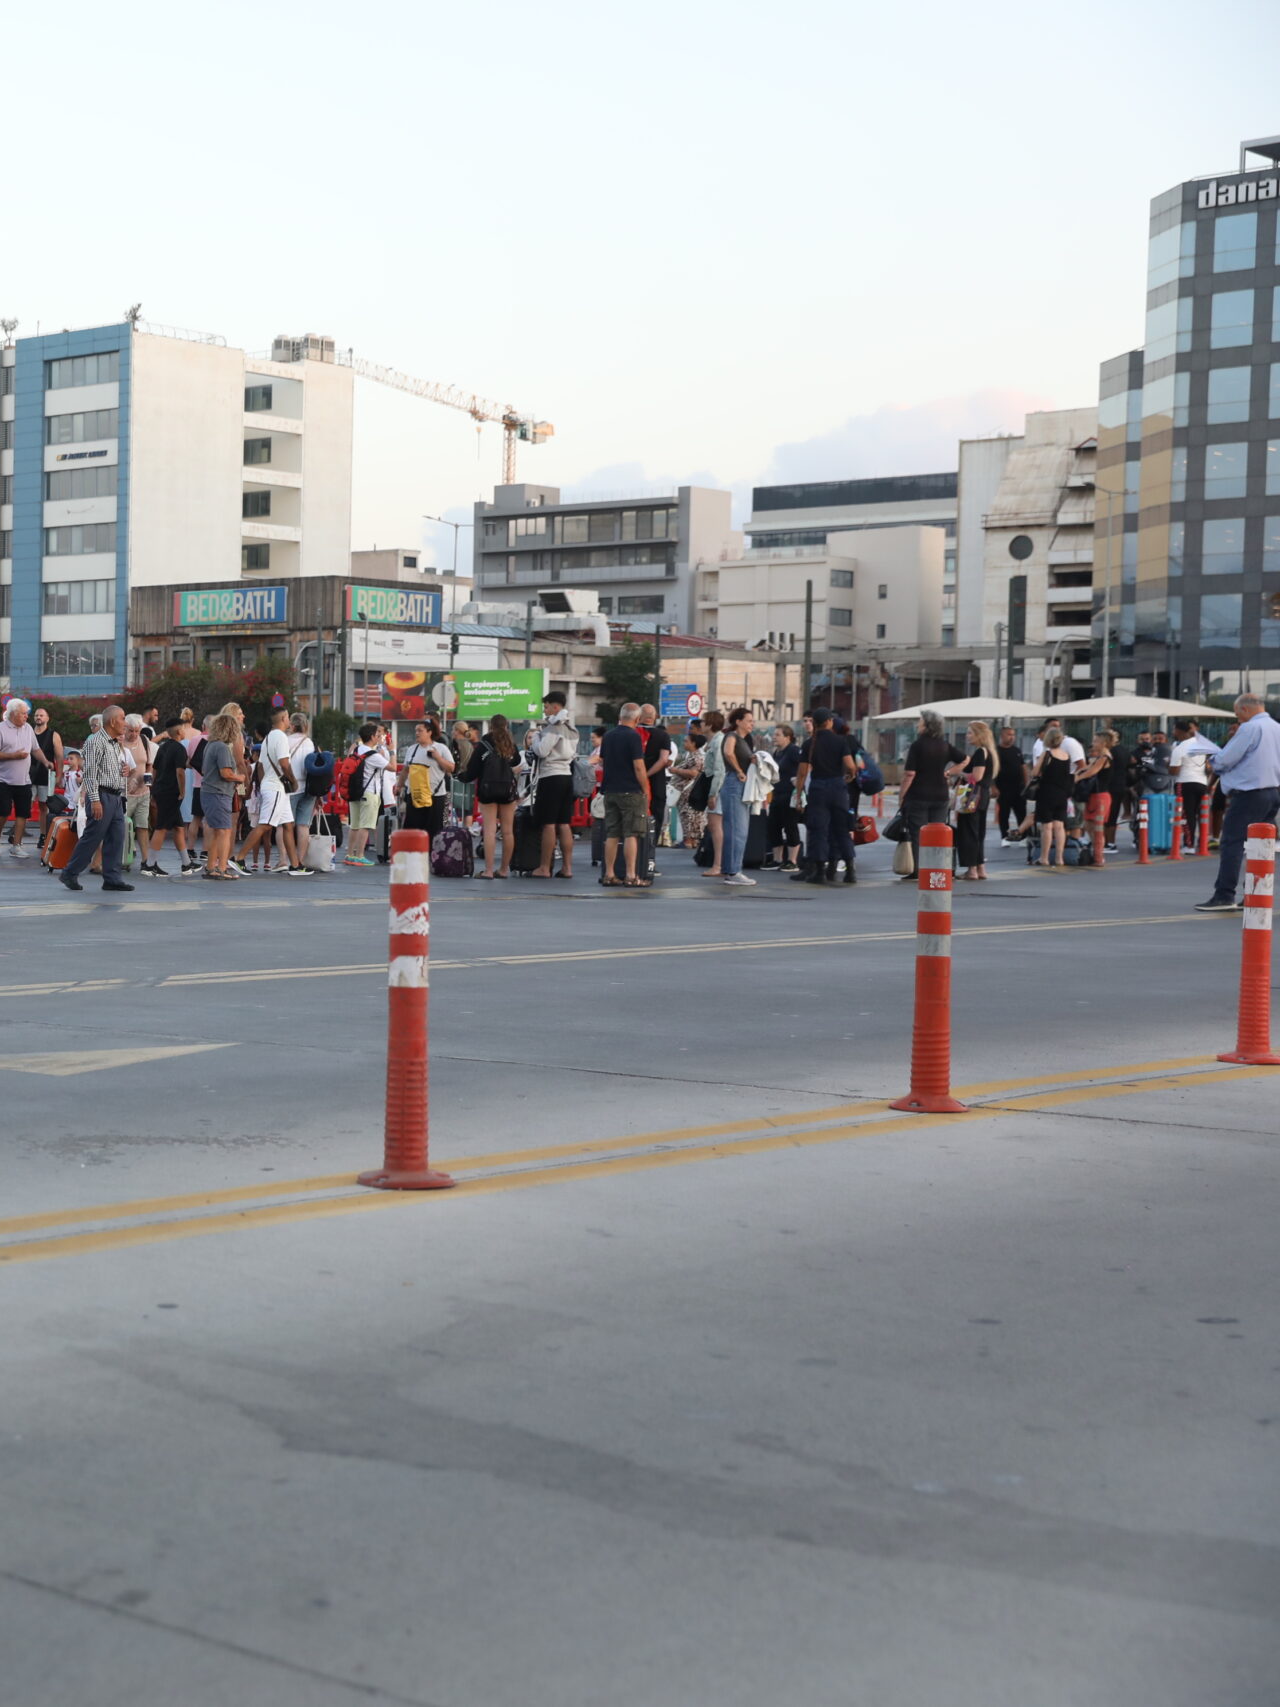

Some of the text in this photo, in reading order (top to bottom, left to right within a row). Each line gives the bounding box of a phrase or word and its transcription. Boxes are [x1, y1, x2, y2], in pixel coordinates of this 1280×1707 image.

[1198, 178, 1280, 209] dana
[187, 590, 275, 622] BED&BATH
[357, 589, 433, 624] BED&BATH
